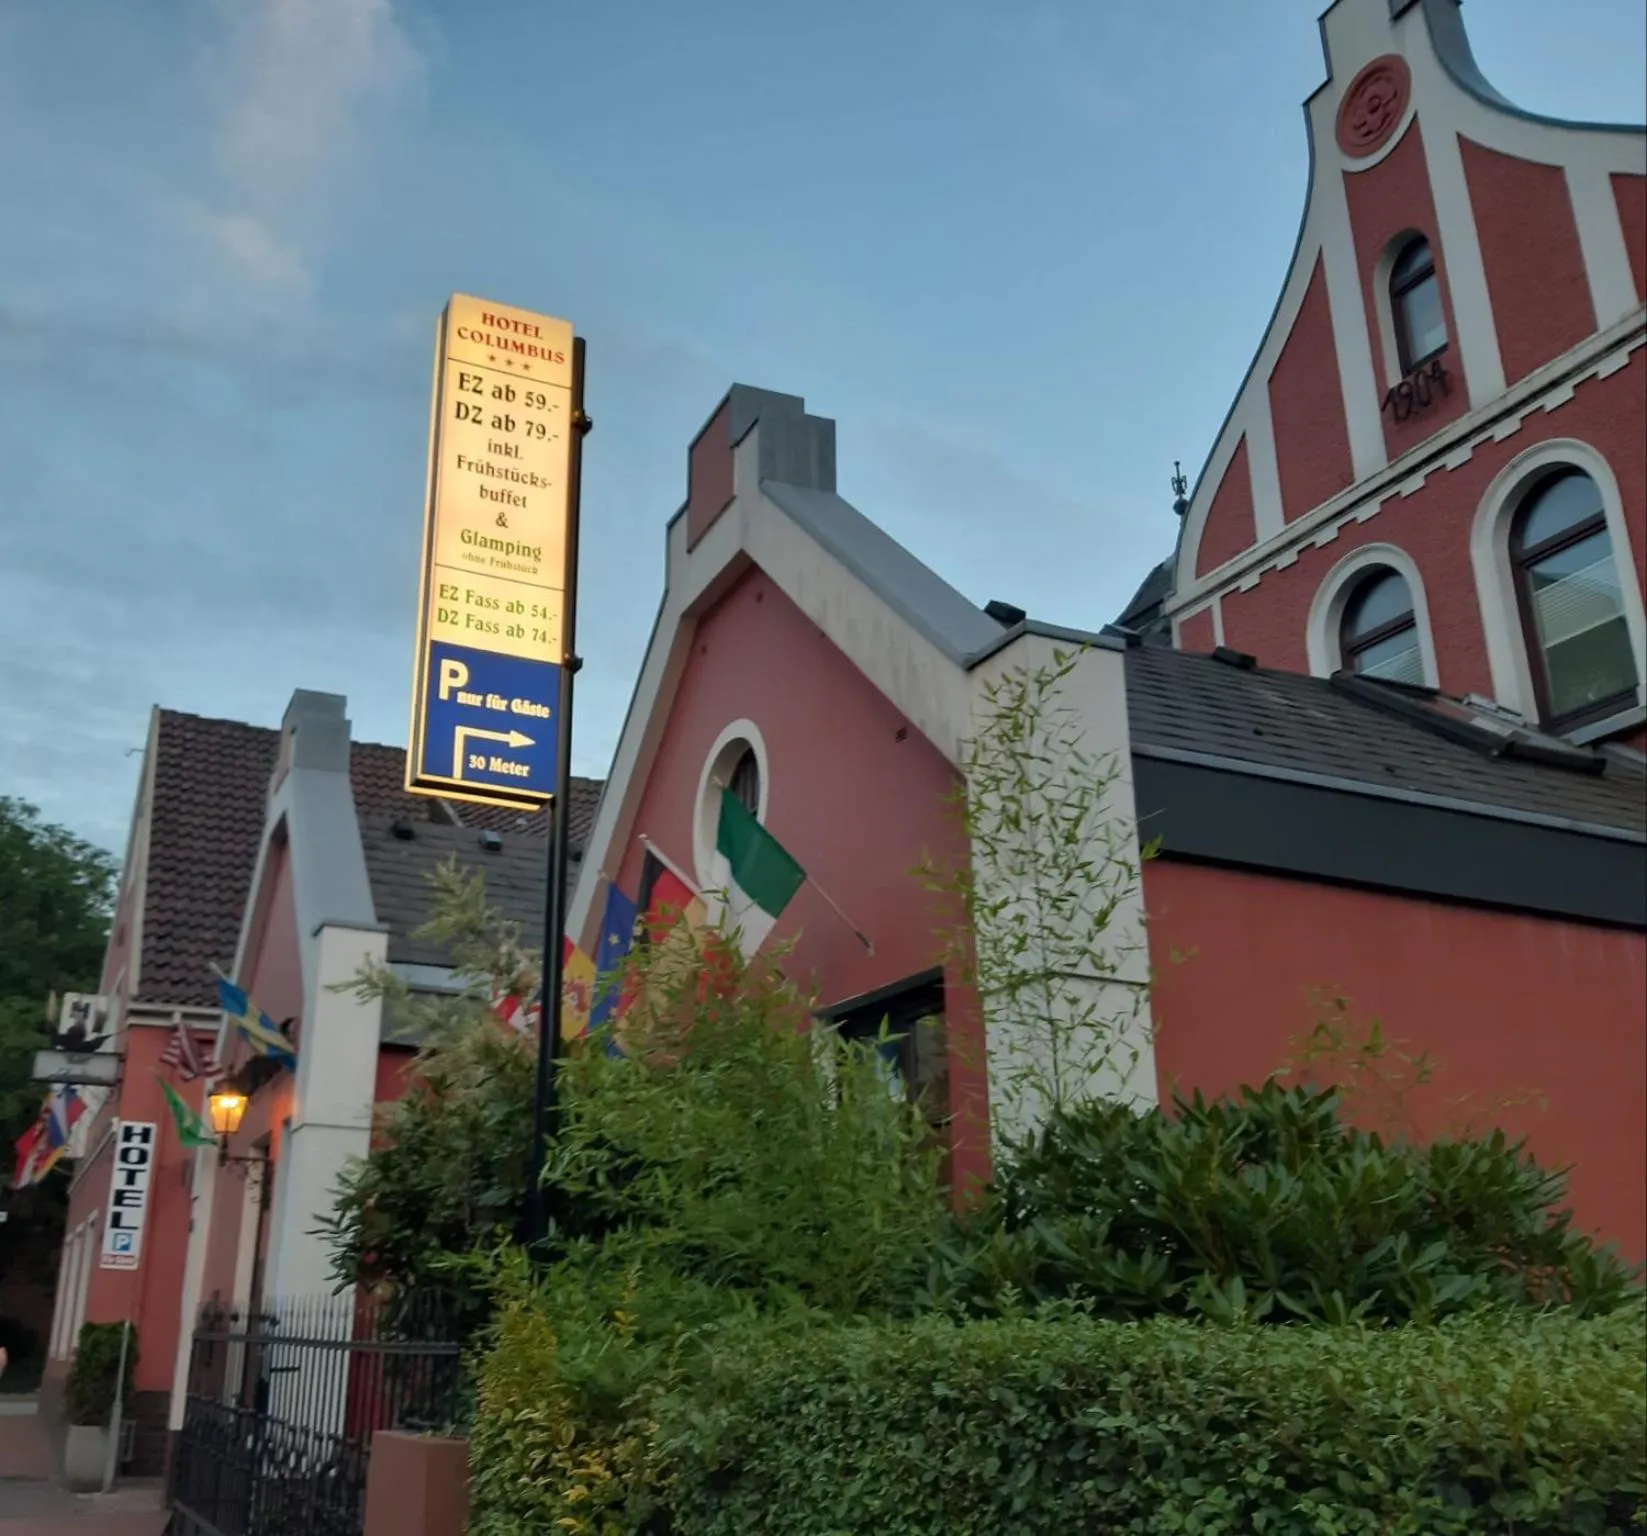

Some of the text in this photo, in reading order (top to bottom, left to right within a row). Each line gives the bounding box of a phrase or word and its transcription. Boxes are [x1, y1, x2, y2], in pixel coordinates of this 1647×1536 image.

[481, 312, 543, 340] HOTEL
[457, 326, 565, 364] COLUMBUS
[458, 372, 560, 412] EZ ab 59.-
[1381, 360, 1449, 425] 1904
[455, 401, 559, 442] DZ ab 79.-
[488, 438, 523, 460] inkl.
[456, 454, 552, 489] Frühstücks-
[479, 484, 527, 508] buffet
[495, 512, 509, 529] &
[460, 529, 542, 562] Glamping
[462, 552, 486, 564] ohne
[439, 583, 558, 620] EZ Fass ab 54.-
[437, 607, 557, 644] DZ Fass ab 74.-
[438, 658, 550, 719] P nur für Gäste
[469, 754, 531, 777] 30 Meter
[109, 1126, 151, 1230] HOTEL
